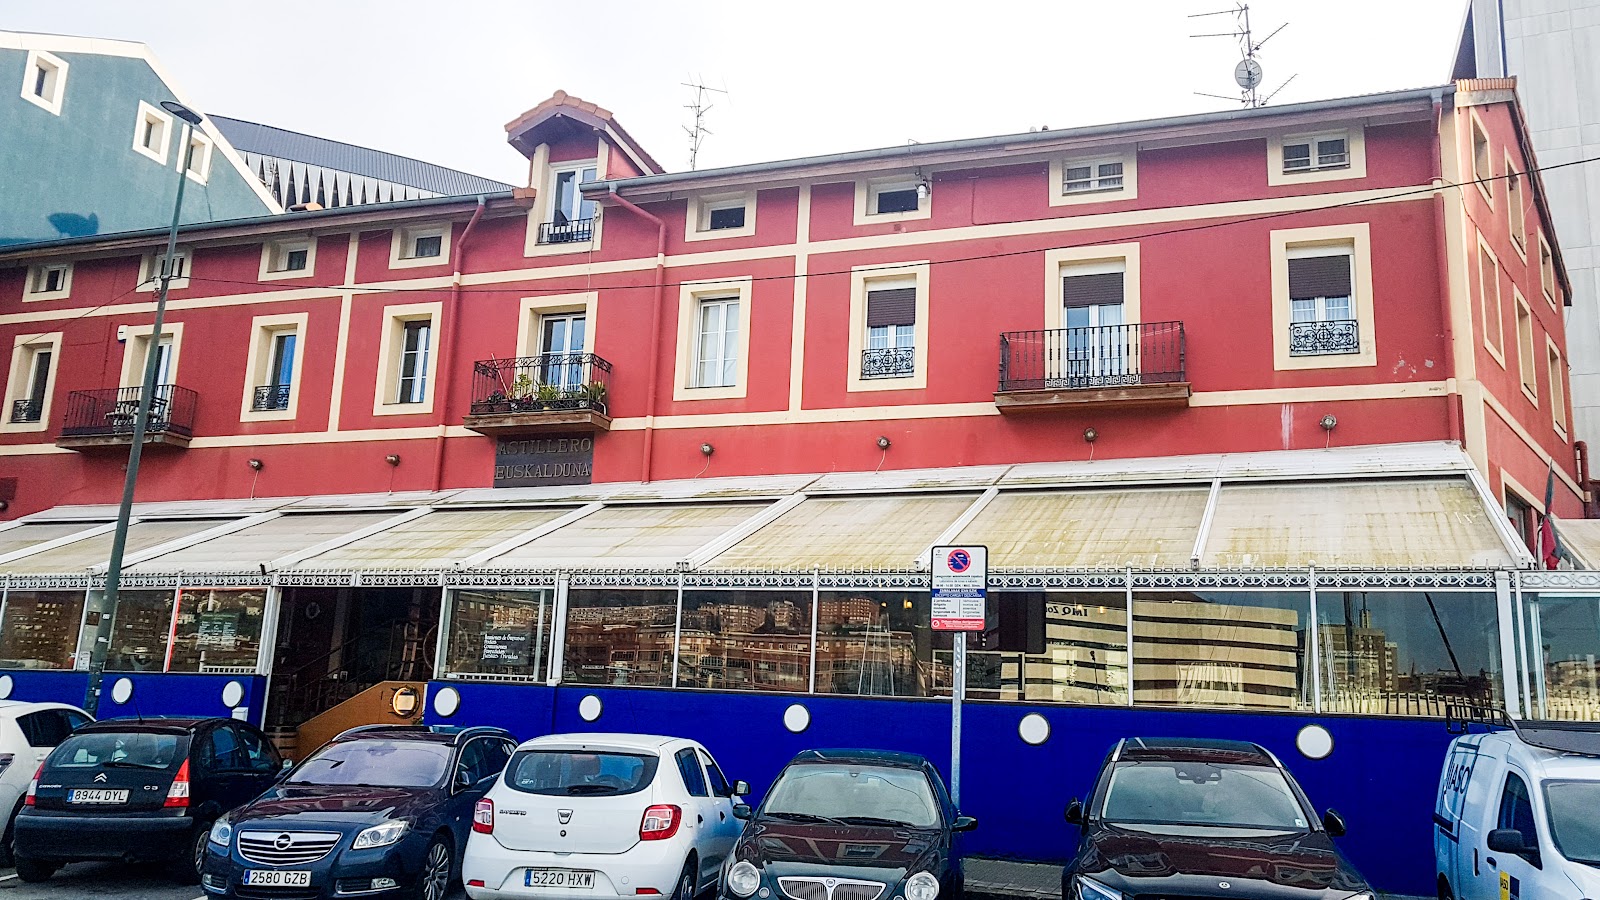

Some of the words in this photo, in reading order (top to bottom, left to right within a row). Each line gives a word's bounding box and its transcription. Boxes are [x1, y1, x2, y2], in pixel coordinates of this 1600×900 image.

[498, 438, 591, 455] ASTILLERO
[495, 462, 590, 480] EUSKALDUNA
[74, 790, 101, 801] 8944
[104, 791, 125, 800] DYL
[251, 871, 281, 884] 2580
[284, 872, 308, 885] GZB
[533, 870, 563, 885] 5220
[567, 872, 591, 886] HXW
